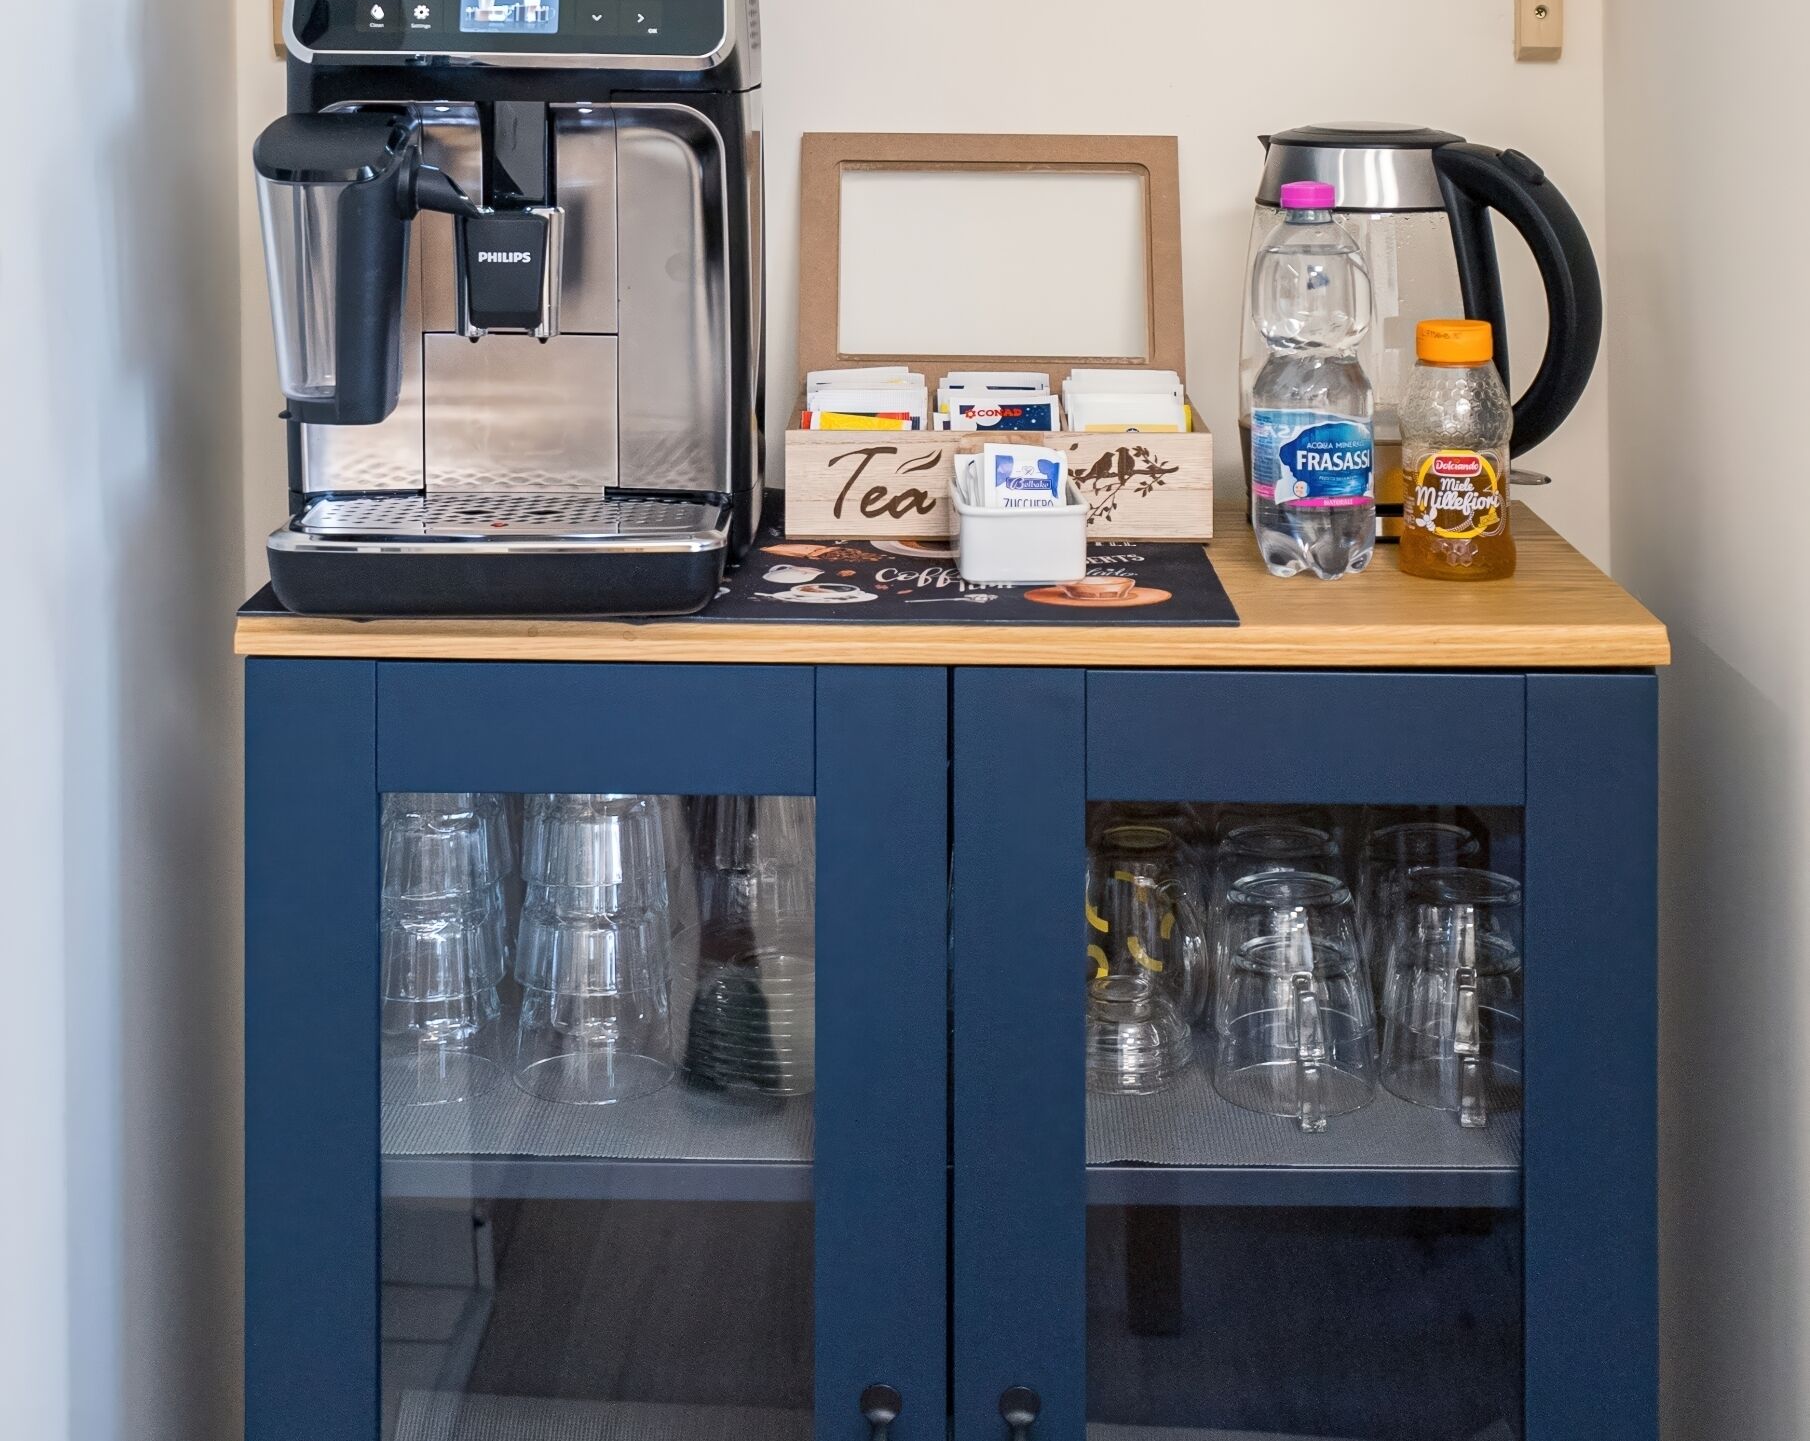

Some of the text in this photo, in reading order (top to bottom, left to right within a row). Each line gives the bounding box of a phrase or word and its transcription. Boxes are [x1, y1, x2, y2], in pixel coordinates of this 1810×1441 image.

[478, 251, 532, 263] PHILIPS
[977, 408, 1023, 418] CONAD
[1306, 441, 1334, 449] ACQUA
[1296, 449, 1370, 471] FRASASSI
[1435, 459, 1479, 471] Dolciando
[828, 445, 937, 520] Tea
[1440, 477, 1475, 492] Miele
[1415, 486, 1501, 515] Millefiori
